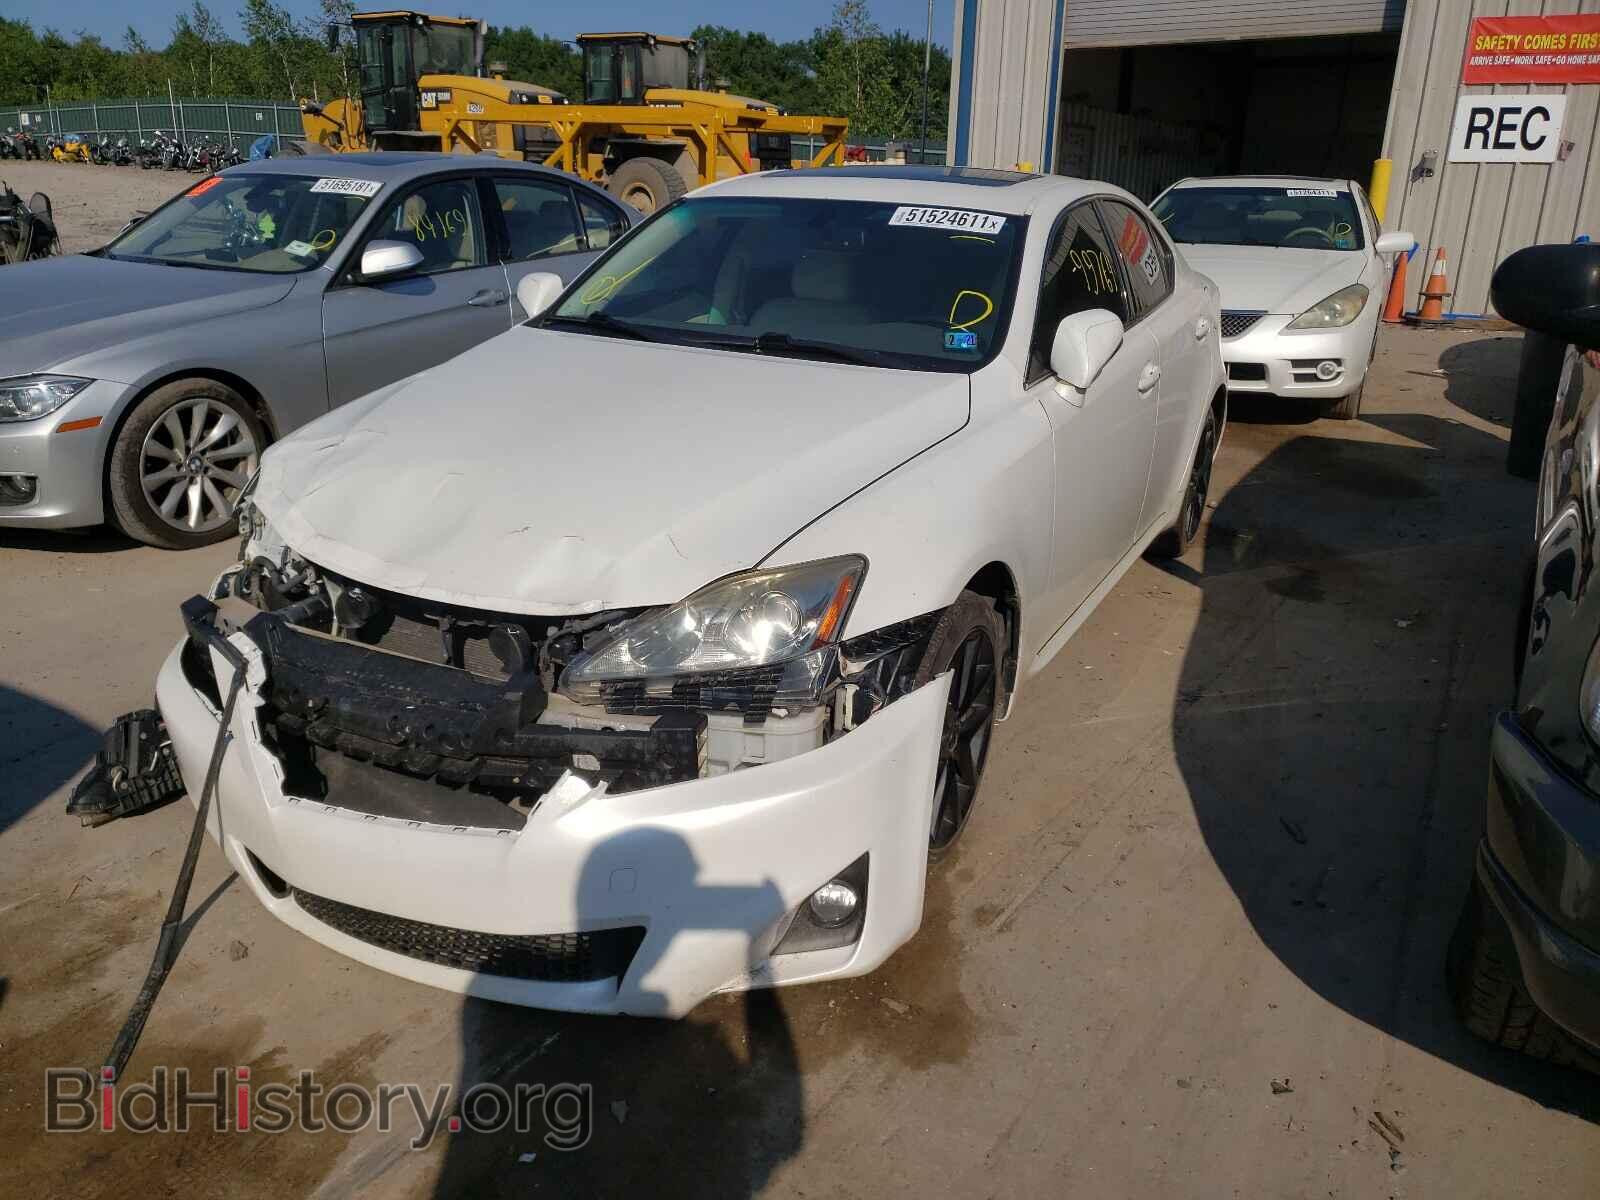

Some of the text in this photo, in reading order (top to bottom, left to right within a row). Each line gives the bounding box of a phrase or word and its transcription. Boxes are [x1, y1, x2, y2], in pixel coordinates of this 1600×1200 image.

[1475, 32, 1600, 51] SAFETY COMES FIRS
[1470, 55, 1493, 65] ARRIVE
[1494, 55, 1510, 65] SAFE
[1514, 55, 1534, 65] WORK
[1535, 55, 1552, 65] SAFE
[1556, 55, 1566, 65] GO
[1567, 54, 1586, 65] HOME
[421, 91, 436, 108] CAT
[1464, 106, 1550, 151] REC
